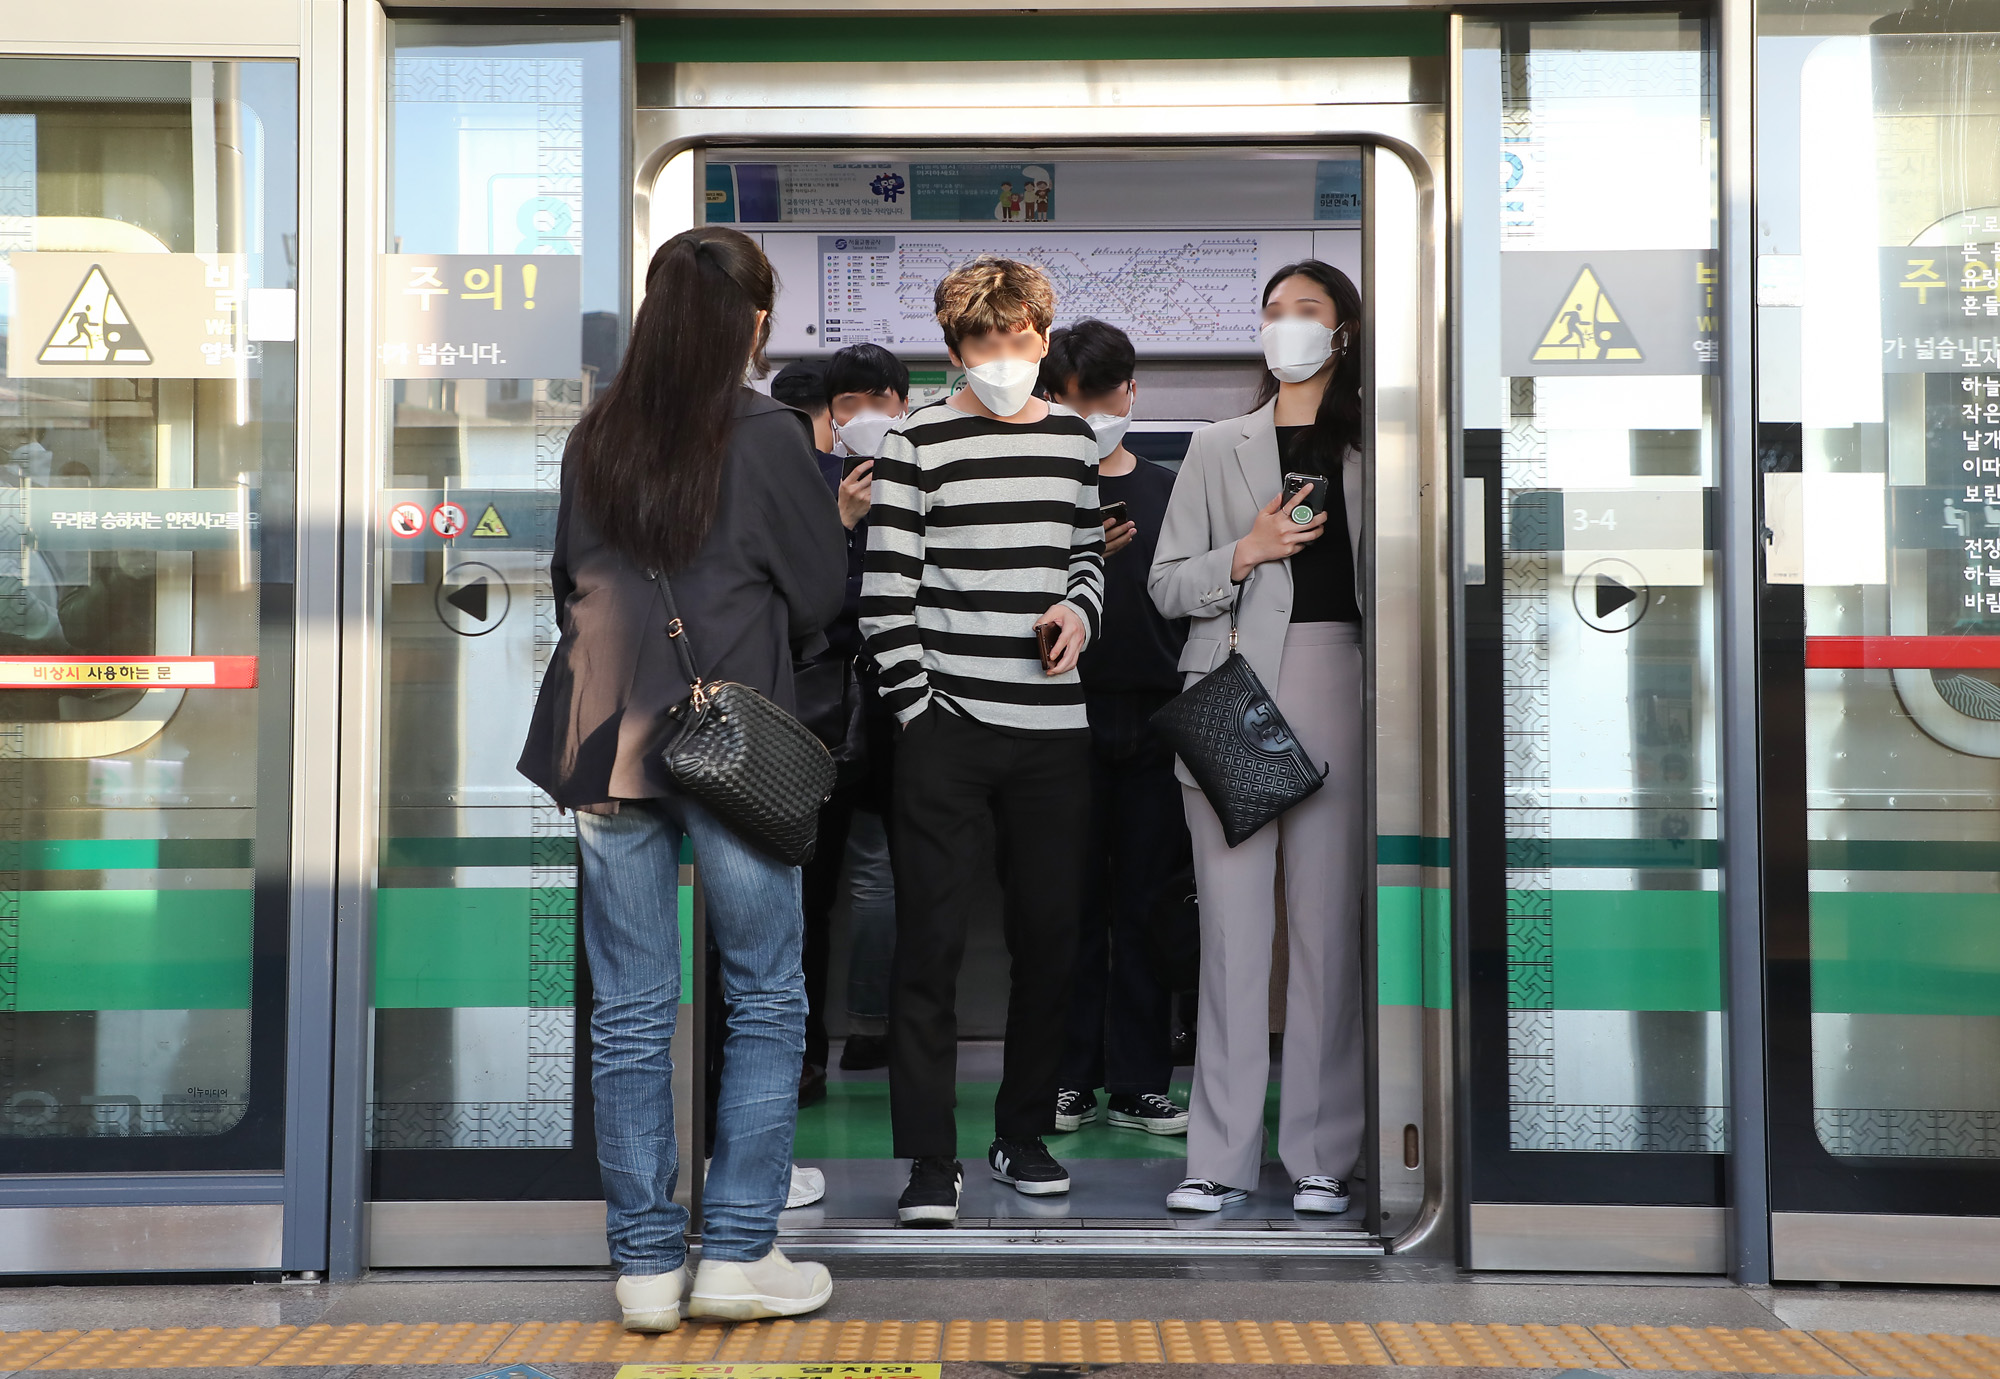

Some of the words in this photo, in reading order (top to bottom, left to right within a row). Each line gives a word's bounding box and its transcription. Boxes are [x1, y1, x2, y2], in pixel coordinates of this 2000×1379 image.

[416, 342, 507, 366] 넓습니다.
[50, 511, 99, 530] 무리한
[100, 511, 163, 530] 승하차는
[1572, 509, 1618, 532] 3-4
[33, 666, 80, 680] 비상시
[87, 665, 150, 681] 사용하는
[157, 666, 171, 681] 문
[187, 1086, 228, 1098] 이누미디어
